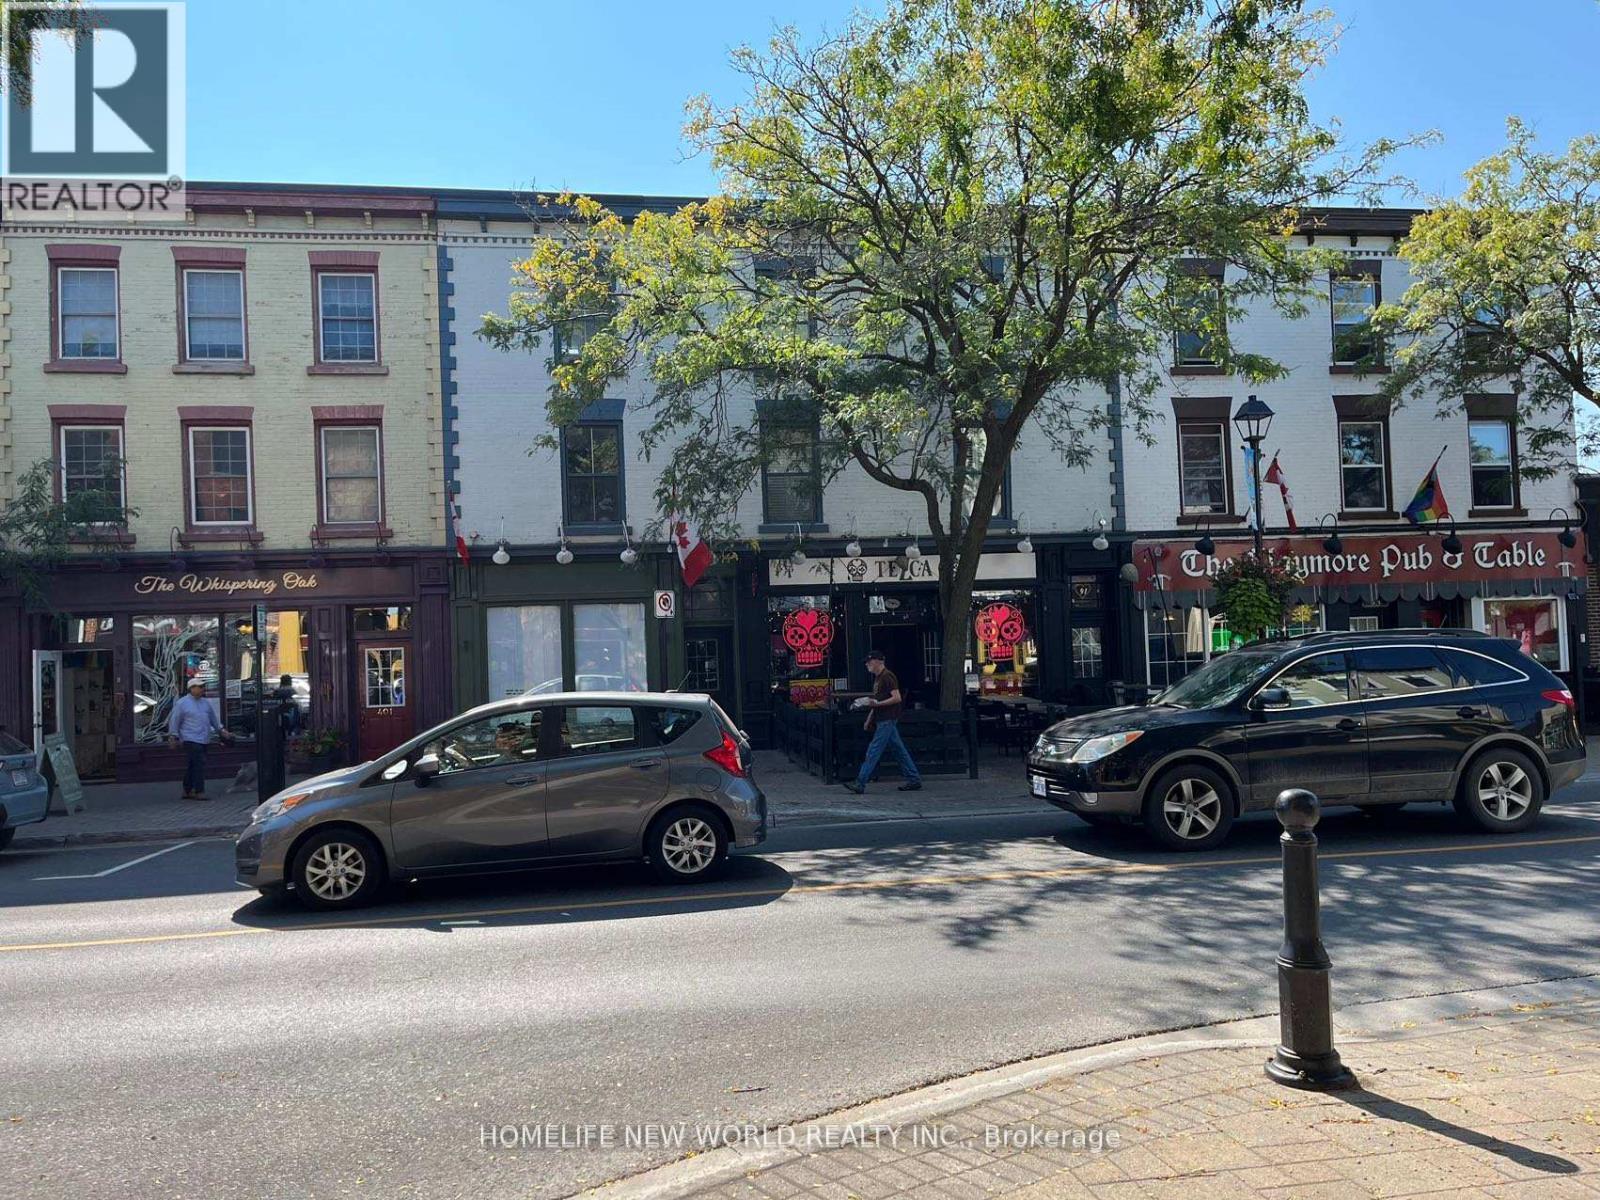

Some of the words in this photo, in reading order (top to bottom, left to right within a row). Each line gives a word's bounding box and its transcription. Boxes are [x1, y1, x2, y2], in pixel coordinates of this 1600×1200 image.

[1381, 543, 1432, 578] Pub
[1473, 541, 1547, 570] Table
[134, 576, 175, 594] The
[179, 573, 277, 595] Whispering
[282, 571, 318, 590] Oak
